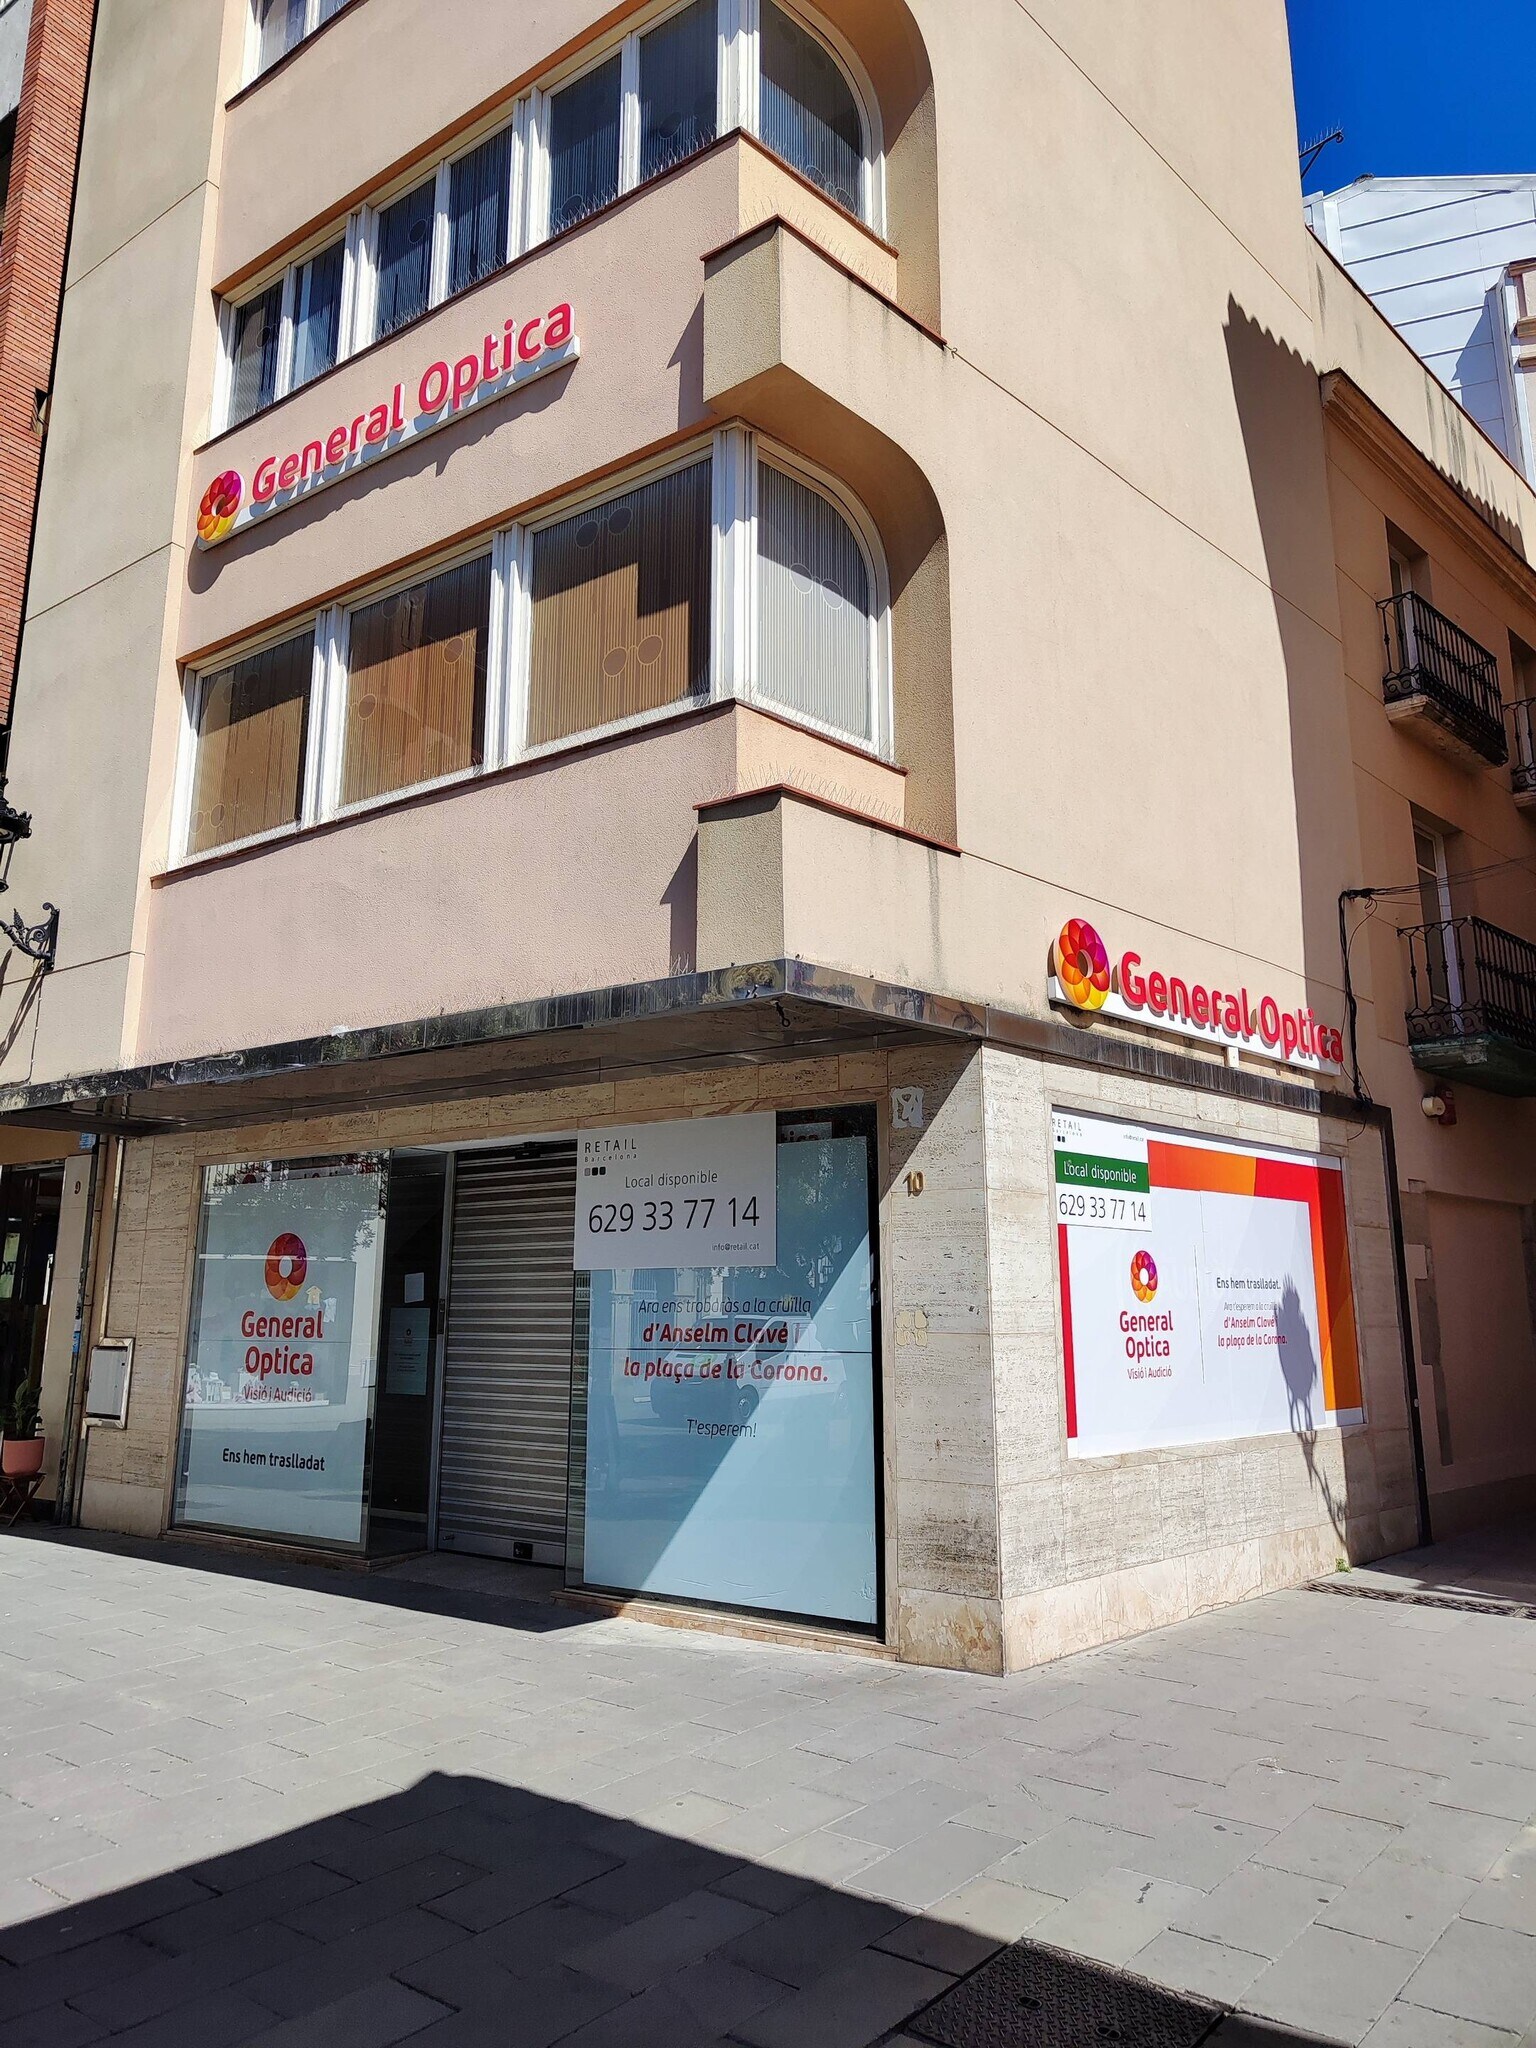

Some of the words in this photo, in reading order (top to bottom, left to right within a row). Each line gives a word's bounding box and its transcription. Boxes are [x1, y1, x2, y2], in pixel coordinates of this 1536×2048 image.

[252, 383, 405, 503] General
[418, 303, 575, 411] Optica
[1119, 951, 1254, 1037] General
[1259, 996, 1344, 1062] Optica
[584, 1138, 637, 1153] RETAIL
[584, 1153, 638, 1163] Barcelona
[625, 1174, 654, 1188] Local
[658, 1170, 718, 1189] disponible
[1063, 1160, 1088, 1177] Local
[1091, 1166, 1137, 1183] disponible
[902, 1171, 924, 1197] 10
[588, 1203, 635, 1233] 629
[642, 1201, 674, 1231] 33
[683, 1198, 716, 1229] 77
[728, 1196, 760, 1227] 14
[1059, 1193, 1086, 1217] 629
[1090, 1196, 1106, 1219] 33
[1110, 1198, 1126, 1220] 77
[1131, 1200, 1147, 1222] 14
[712, 1242, 760, 1251] info@retail.cat
[1216, 1277, 1230, 1288] Ens
[1230, 1277, 1246, 1289] hem
[1246, 1278, 1281, 1289] traslladat.
[638, 1299, 659, 1313] Ara
[662, 1301, 683, 1313] ens
[686, 1297, 739, 1313] trobaràs
[742, 1303, 750, 1313] a
[753, 1299, 767, 1313] la
[241, 1310, 324, 1339] General
[1119, 1310, 1174, 1332] General
[643, 1322, 728, 1343] d'Anselm
[734, 1322, 789, 1343] Clavé
[1246, 1334, 1255, 1345] de
[1125, 1335, 1170, 1364] Optica
[245, 1345, 314, 1380] Optica
[623, 1357, 641, 1377] la
[644, 1358, 695, 1383] plaça
[700, 1358, 722, 1380] de
[727, 1358, 745, 1380] la
[751, 1359, 828, 1382] Corona.
[1127, 1367, 1144, 1379] Visió
[1149, 1366, 1172, 1378] Audició
[243, 1385, 268, 1400] Visió
[269, 1386, 273, 1400] i
[273, 1387, 312, 1402] Audició
[687, 1419, 757, 1439] T'esperem!
[222, 1448, 241, 1464] Ens
[243, 1449, 267, 1466] hem
[269, 1452, 325, 1471] traslladat
